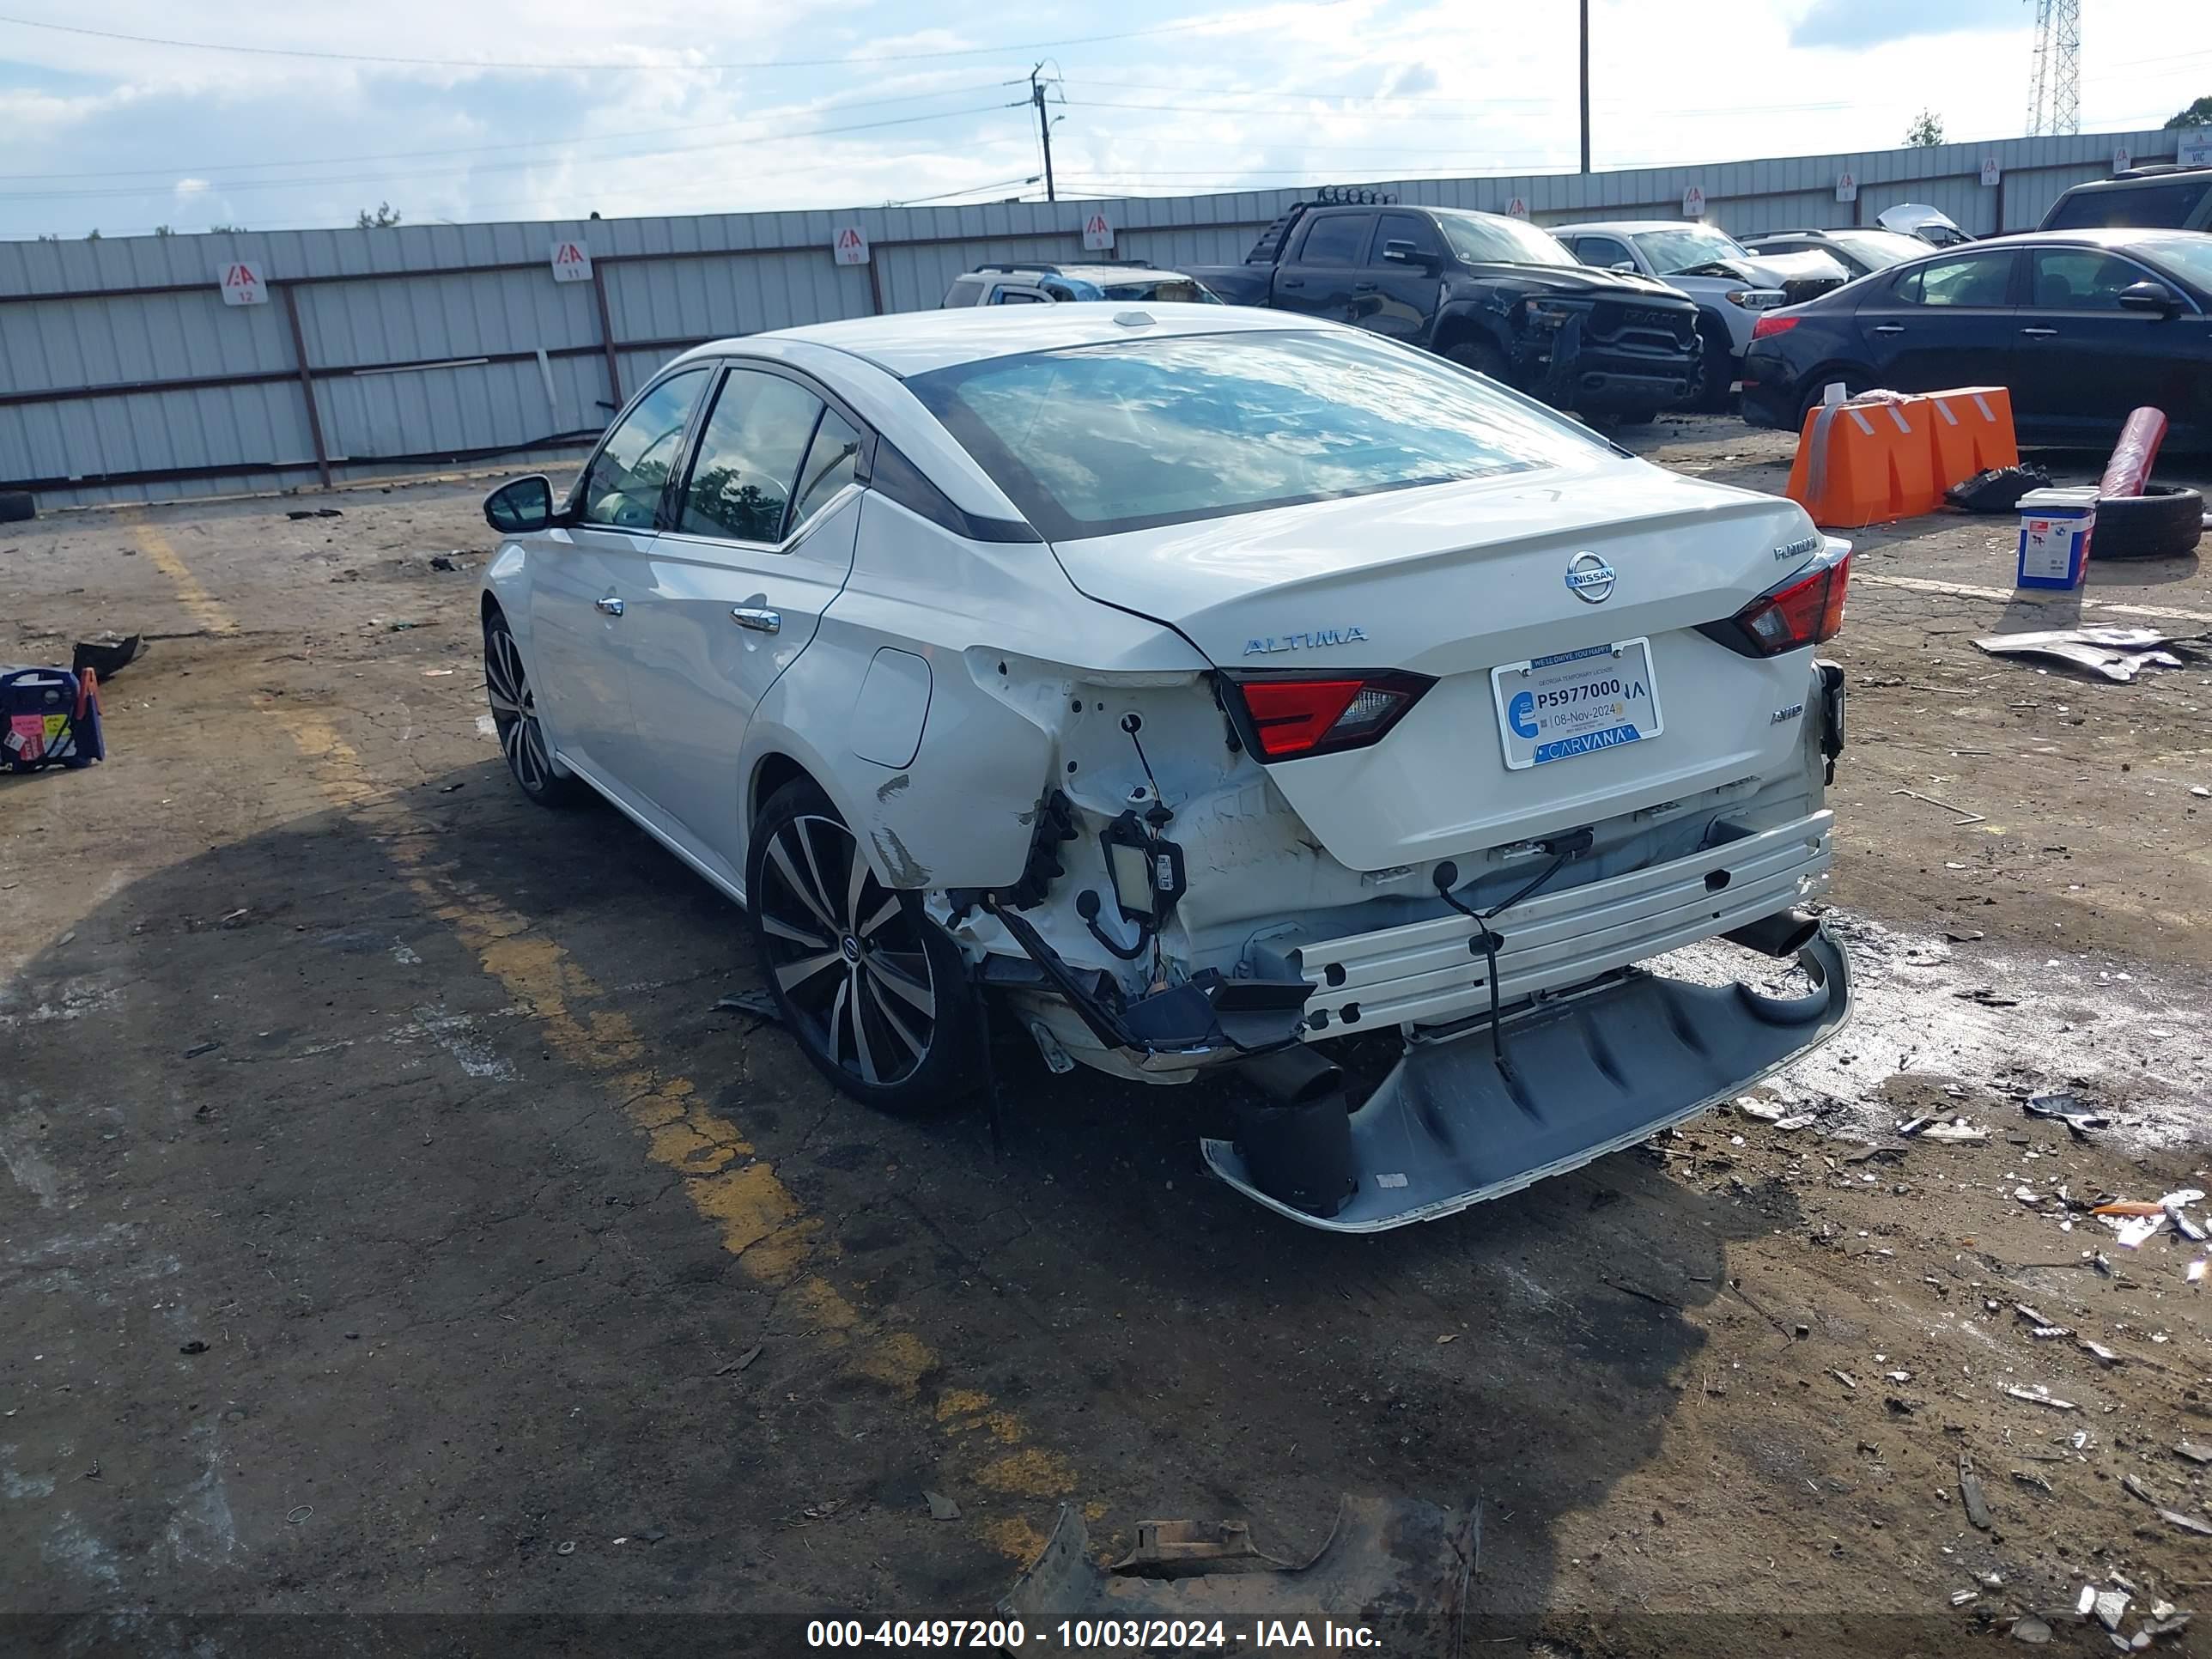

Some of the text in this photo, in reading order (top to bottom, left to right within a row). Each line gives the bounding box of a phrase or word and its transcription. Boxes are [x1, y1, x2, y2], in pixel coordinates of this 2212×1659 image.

[239, 291, 254, 302] 12
[1573, 568, 1614, 585] NISSAN
[1243, 624, 1370, 657] ALTIMA
[1554, 653, 1575, 665] DRIVE
[1575, 649, 1589, 659] YOU
[1589, 645, 1610, 657] HAPPY
[1538, 666, 1615, 687] GEORGIA TEMPORARY LICENSE
[1537, 678, 1621, 709] P5977000
[1553, 702, 1616, 726] 08-Nov-2024
[1770, 703, 1803, 726] AWD
[1547, 726, 1626, 759] CARVANA
